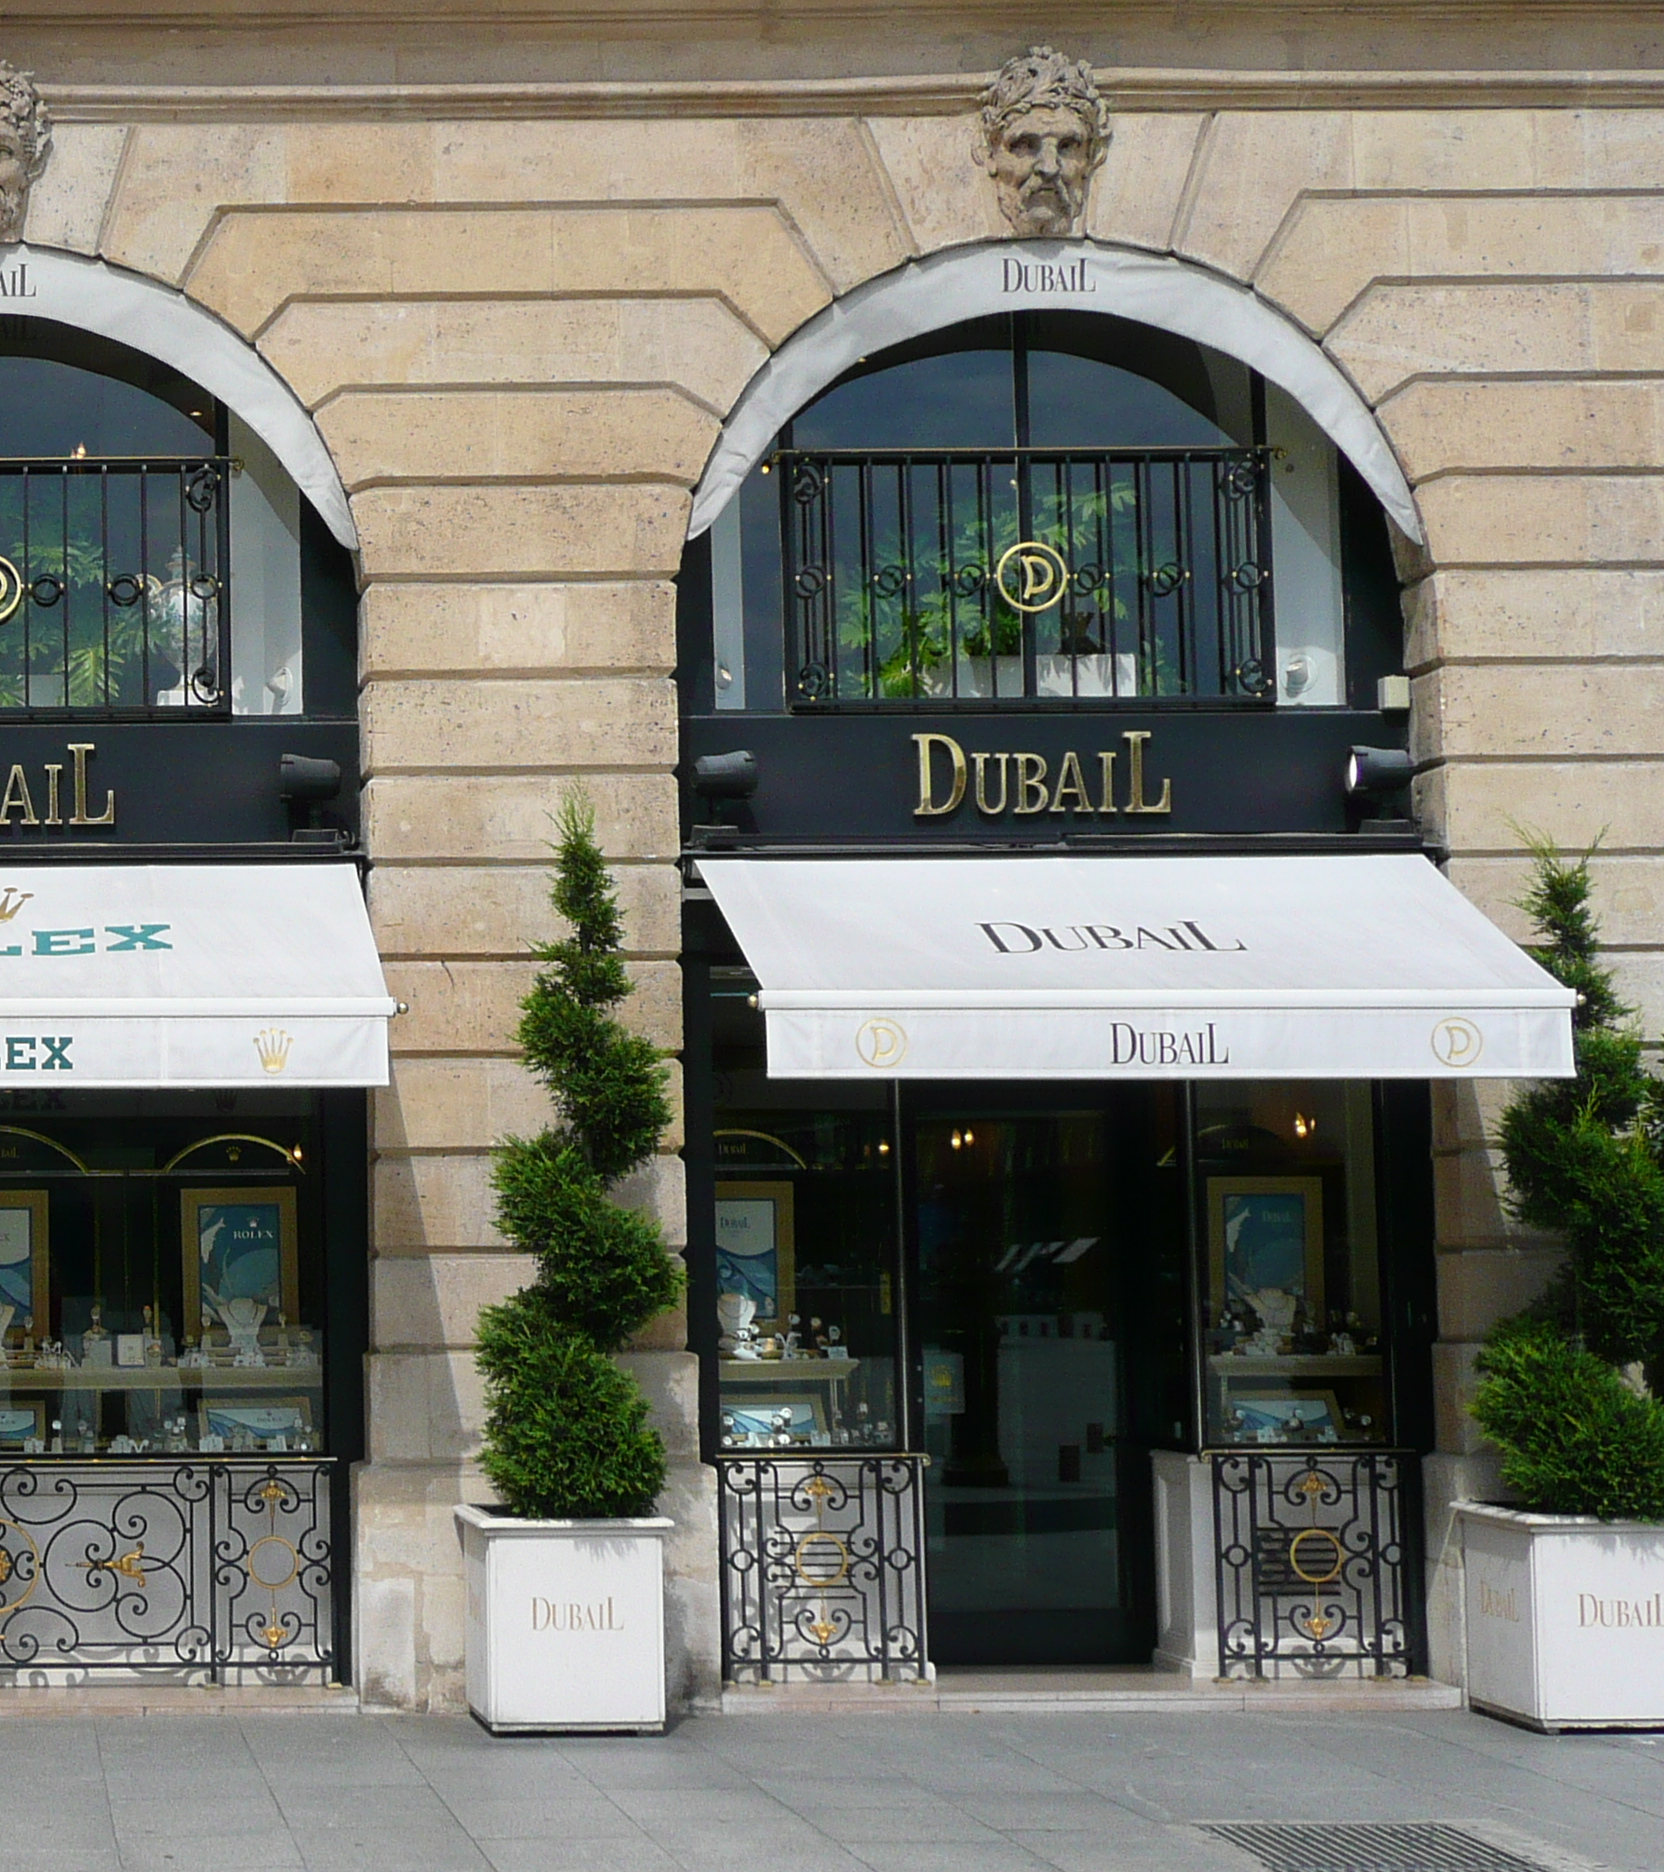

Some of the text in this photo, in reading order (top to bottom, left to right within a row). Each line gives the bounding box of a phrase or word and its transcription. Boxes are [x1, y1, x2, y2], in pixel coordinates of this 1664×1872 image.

[1002, 257, 1096, 292] DUBAIL
[911, 731, 1171, 815] DUBAIL
[976, 919, 1248, 953] DUBAIL
[1110, 1022, 1229, 1065] DUBAIL
[232, 1230, 274, 1241] ROLEX
[532, 1596, 625, 1631] DUBAIL
